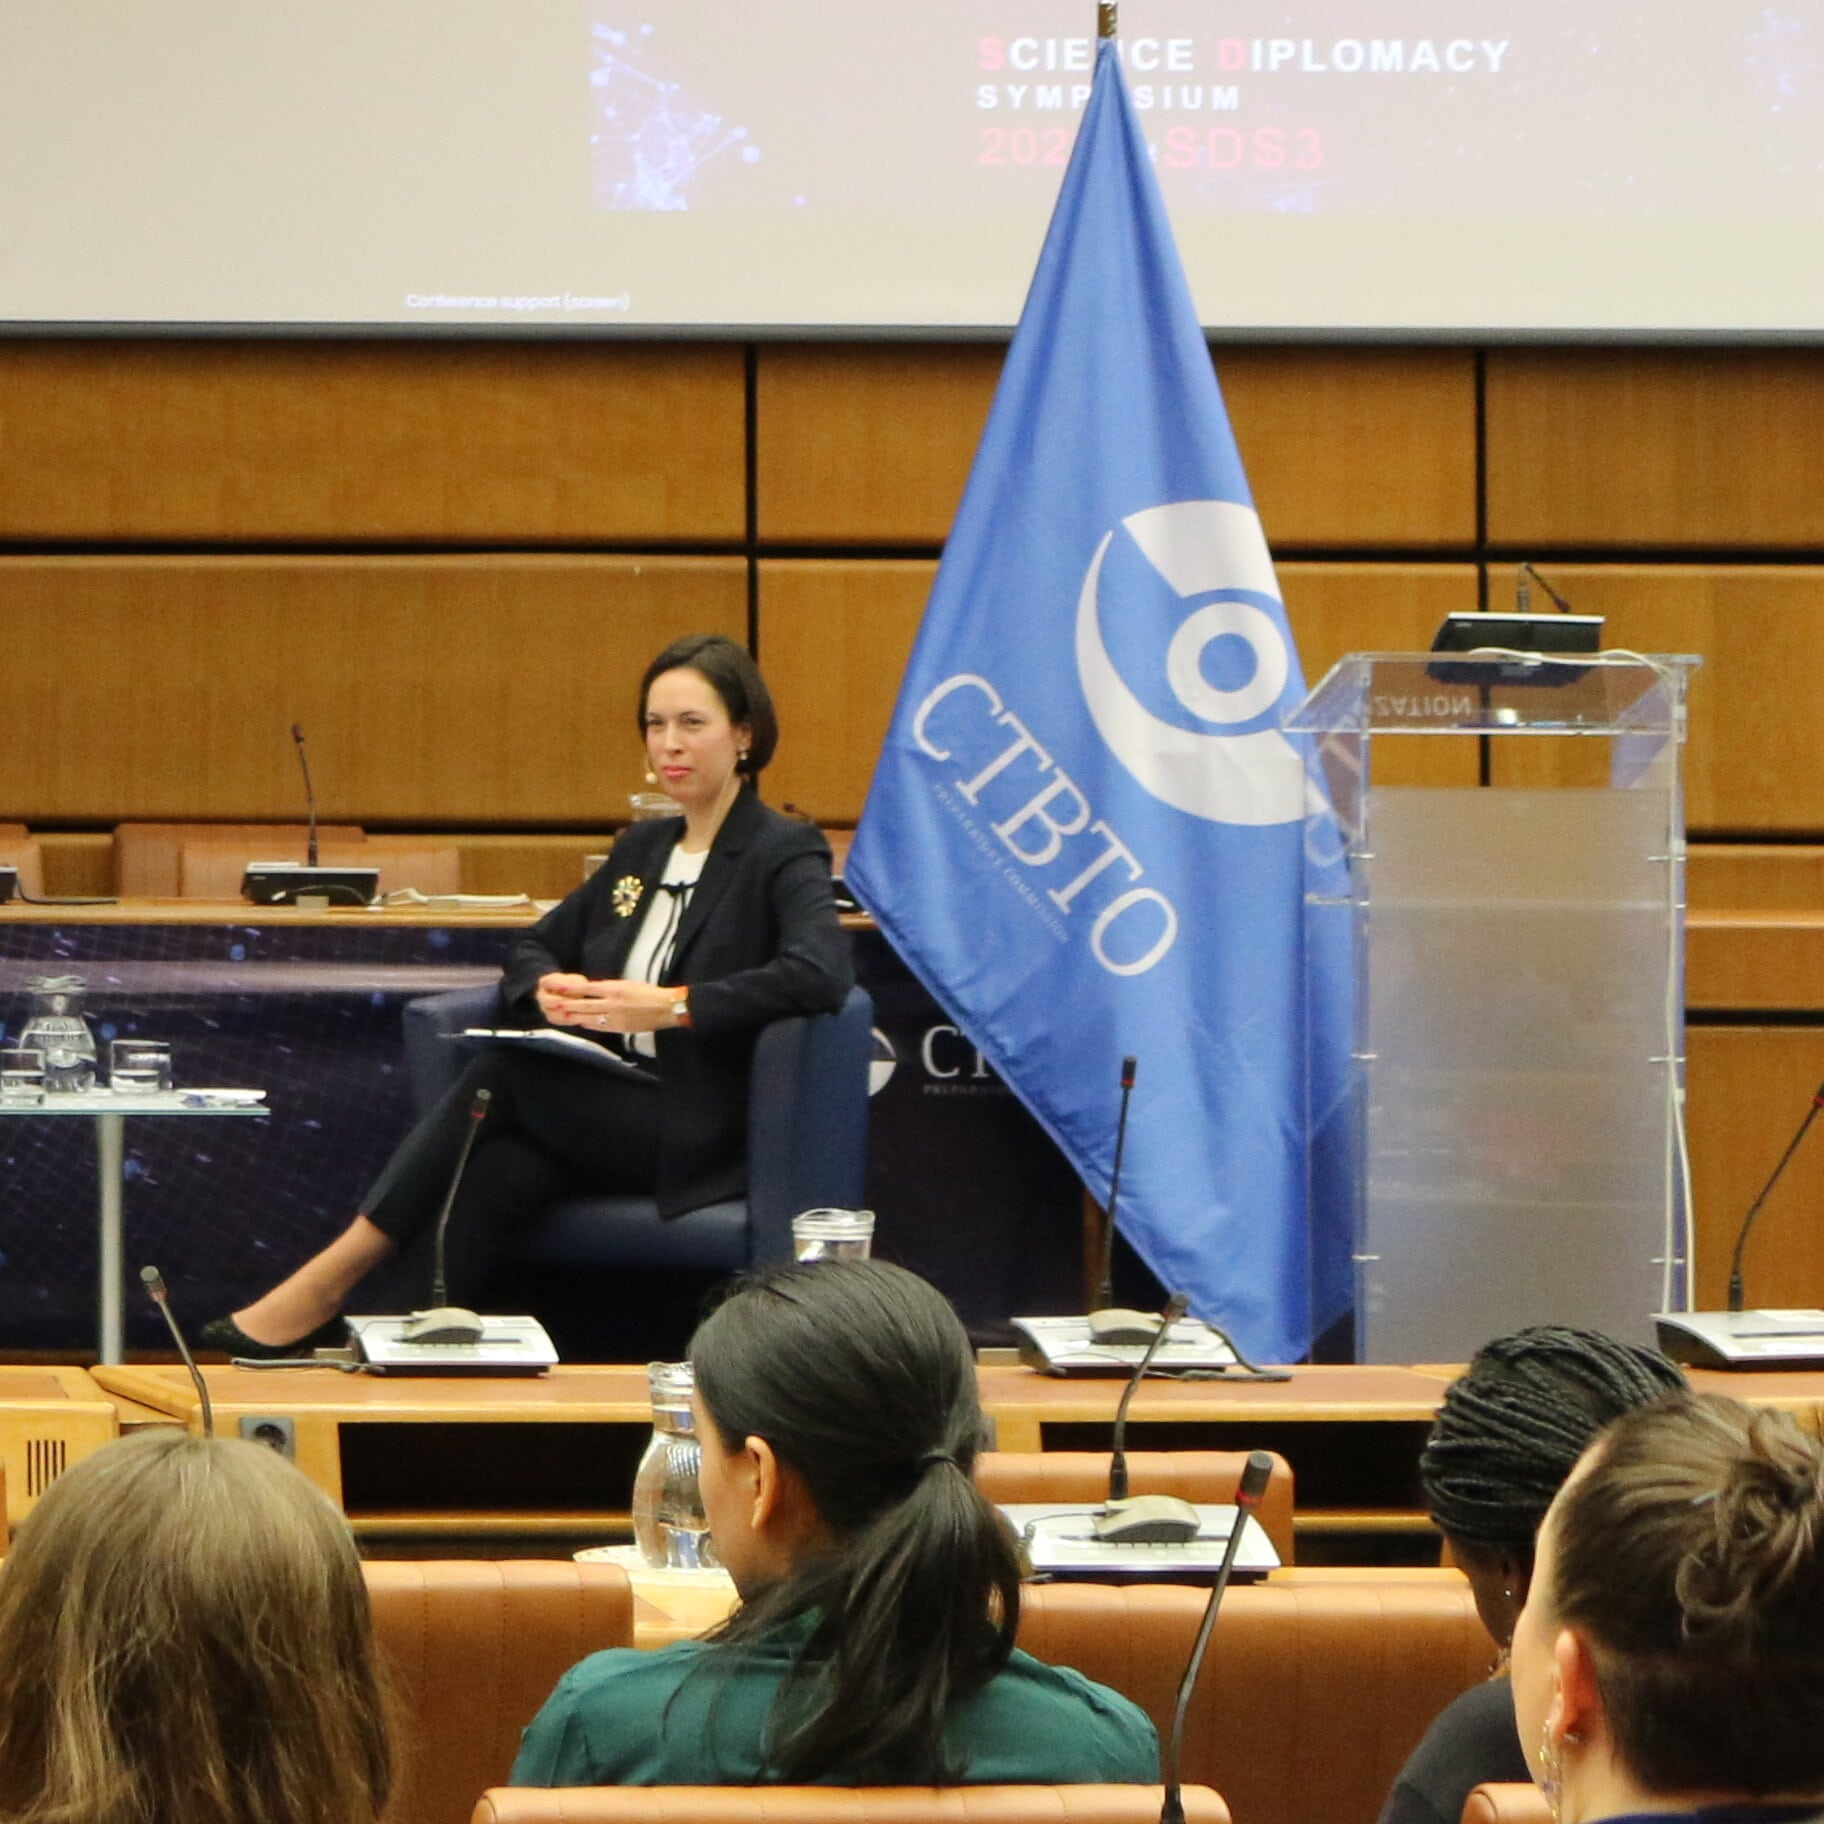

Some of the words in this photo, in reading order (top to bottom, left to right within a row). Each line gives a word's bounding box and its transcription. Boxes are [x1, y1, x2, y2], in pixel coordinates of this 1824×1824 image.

[1218, 38, 1510, 72] DIPLOMACY
[976, 84, 1239, 111] SYMPSIUM
[979, 127, 1072, 166] 202
[913, 673, 1178, 976] CTBTO
